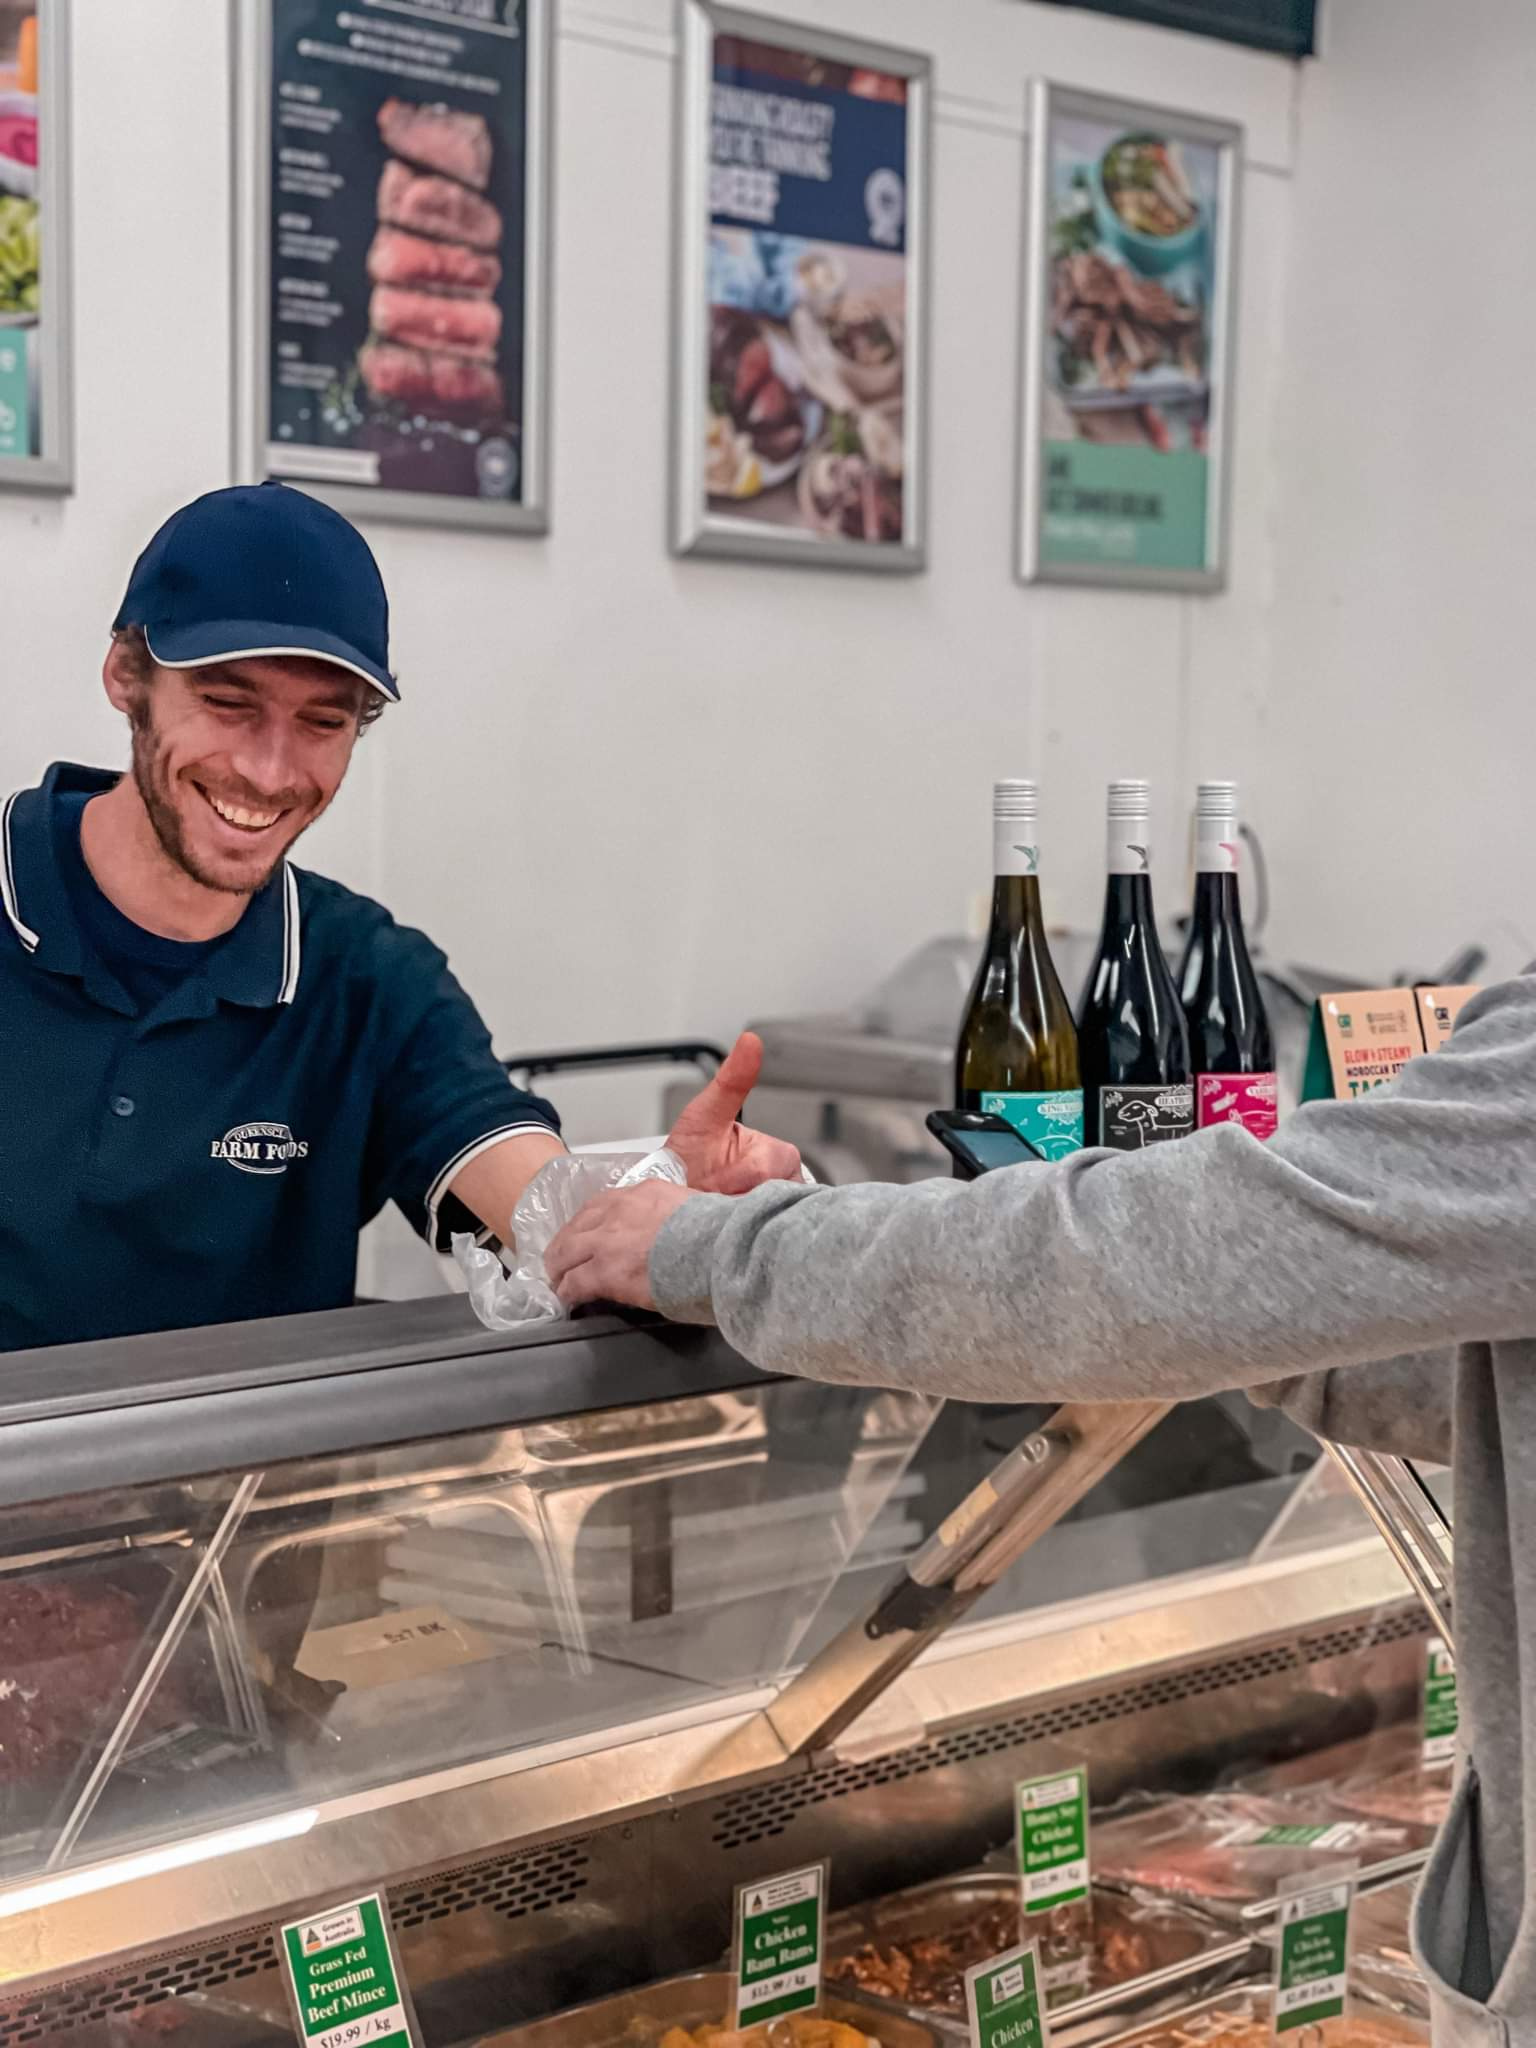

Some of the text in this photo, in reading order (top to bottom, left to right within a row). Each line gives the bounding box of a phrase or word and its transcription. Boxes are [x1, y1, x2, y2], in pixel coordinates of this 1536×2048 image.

[1346, 1063, 1389, 1077] MOROCCAN
[210, 1141, 260, 1159] FARM
[322, 1916, 353, 1932] Grown in
[325, 1927, 355, 1942] Australia
[754, 1924, 807, 1950] Chicken
[309, 1946, 367, 1977] Grass Fed
[309, 1966, 376, 2000] Premium
[307, 1986, 387, 2023] Beef Mince
[320, 2026, 361, 2048] $19.99
[374, 2017, 392, 2032] kg
[991, 2018, 1034, 2048] Chicken
